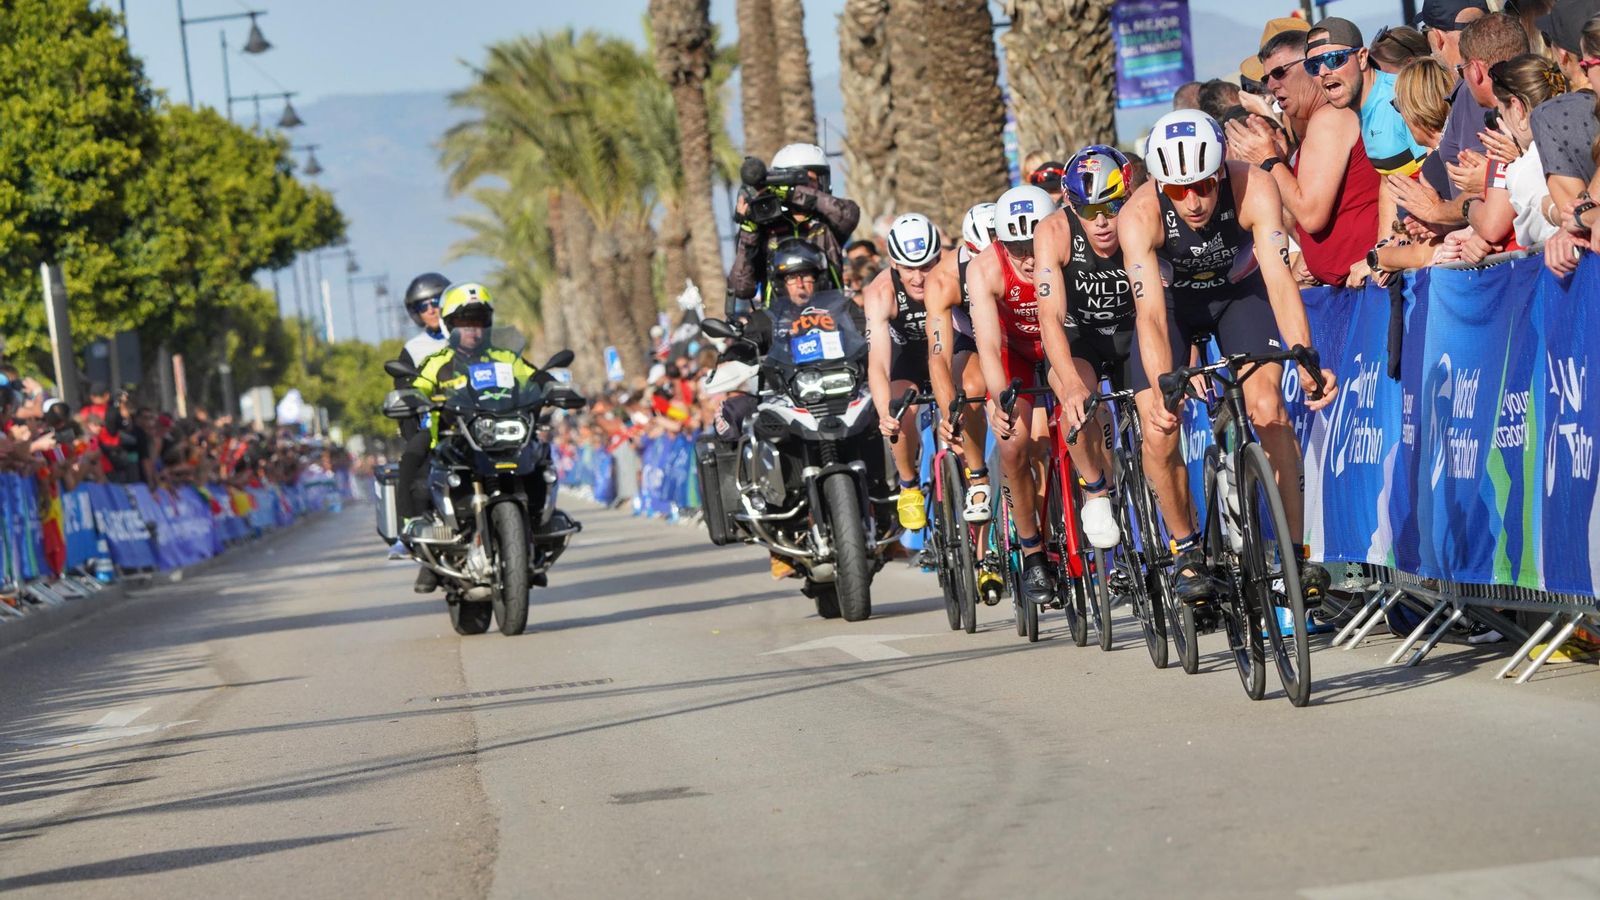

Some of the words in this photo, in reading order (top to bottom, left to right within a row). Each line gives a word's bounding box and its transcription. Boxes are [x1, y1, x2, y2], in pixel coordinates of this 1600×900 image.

[1039, 282, 1051, 297] 3
[1075, 279, 1130, 296] WILD
[1133, 280, 1144, 299] 2
[1087, 296, 1128, 309] NZL
[791, 314, 835, 334] rtve
[1103, 422, 1113, 450] 26
